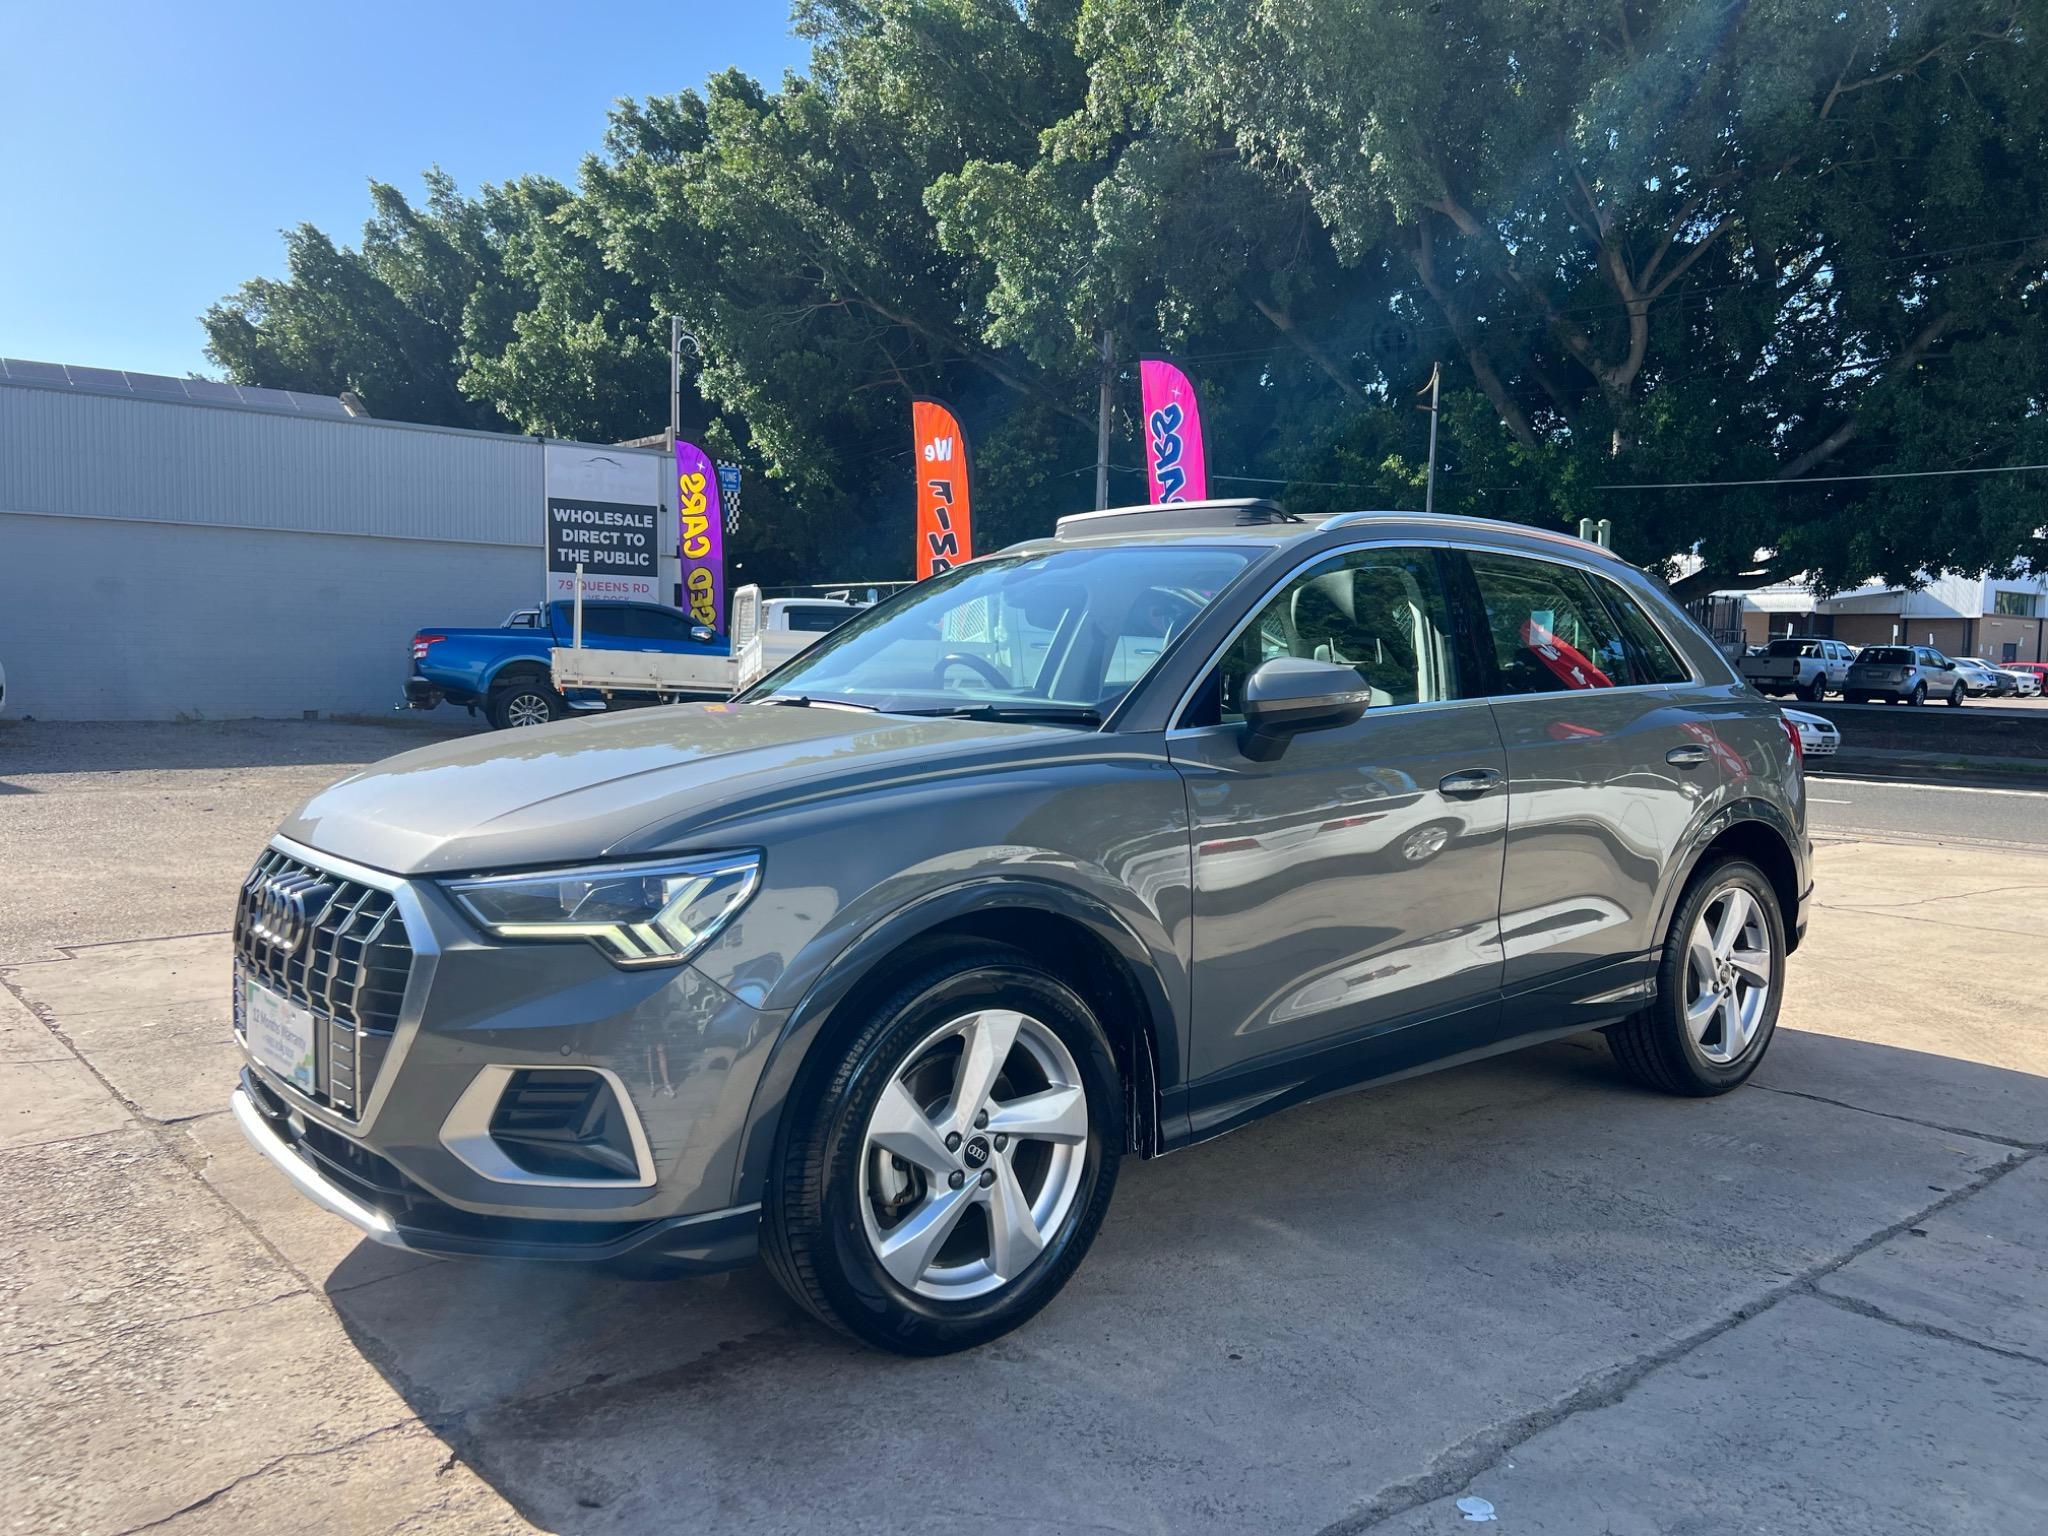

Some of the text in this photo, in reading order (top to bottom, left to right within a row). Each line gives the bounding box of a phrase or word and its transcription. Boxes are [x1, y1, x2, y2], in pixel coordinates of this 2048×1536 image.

[553, 508, 653, 528] WHOLESALE
[562, 528, 646, 547] DIRECT TO
[558, 548, 650, 566] THE PUBLIC
[558, 580, 650, 593] 79 QUEENS RD
